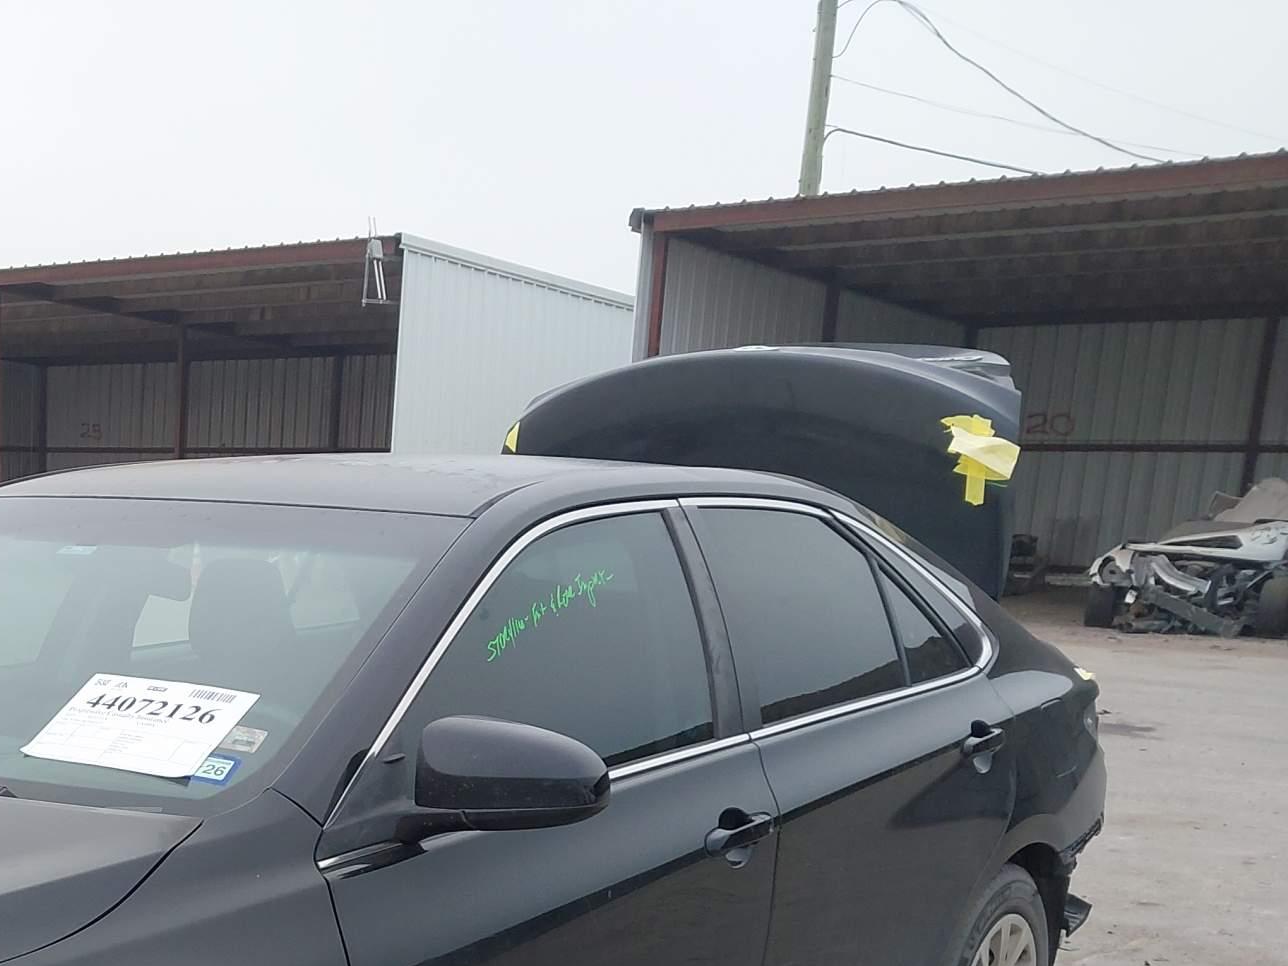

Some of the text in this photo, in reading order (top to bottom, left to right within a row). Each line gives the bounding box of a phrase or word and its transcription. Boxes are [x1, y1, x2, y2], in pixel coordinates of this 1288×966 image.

[1025, 414, 1076, 436] 20
[85, 692, 224, 726] 44072126
[202, 764, 227, 777] 26
